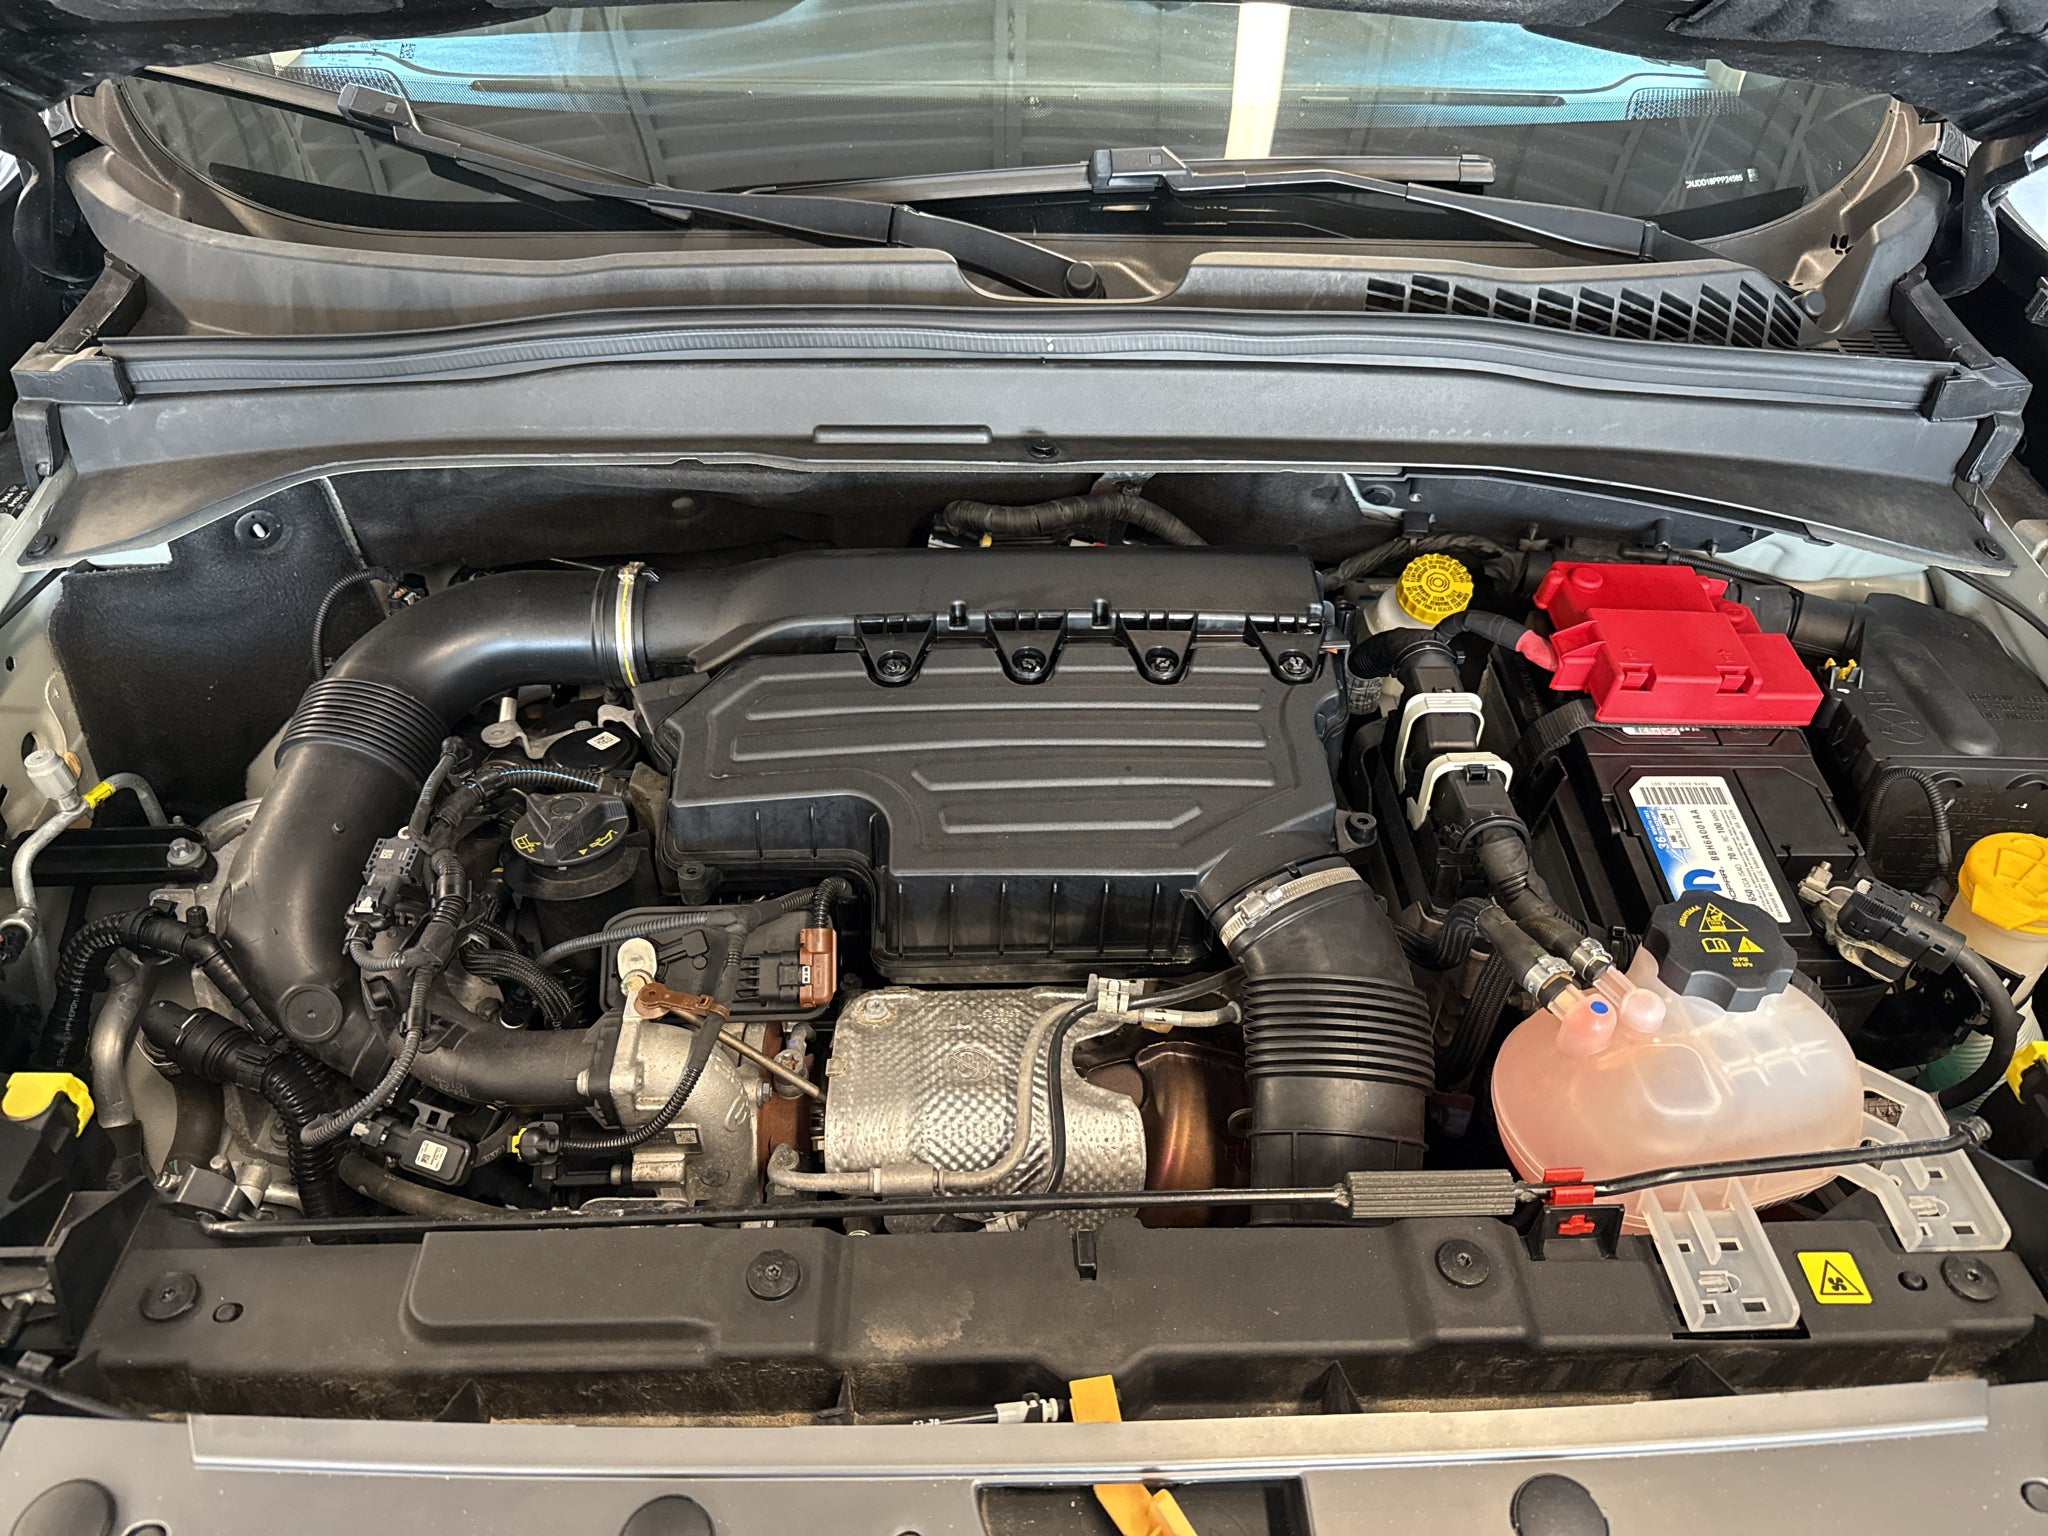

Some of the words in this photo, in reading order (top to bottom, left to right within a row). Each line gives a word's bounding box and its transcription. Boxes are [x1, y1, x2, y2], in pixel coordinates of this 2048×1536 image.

[1713, 822, 1725, 833] 100
[1689, 809, 1720, 860] BBH6A001AA
[1655, 836, 1670, 850] 36
[1727, 852, 1738, 860] 70
[1740, 877, 1750, 887] CCA
[1744, 889, 1757, 901] 650
